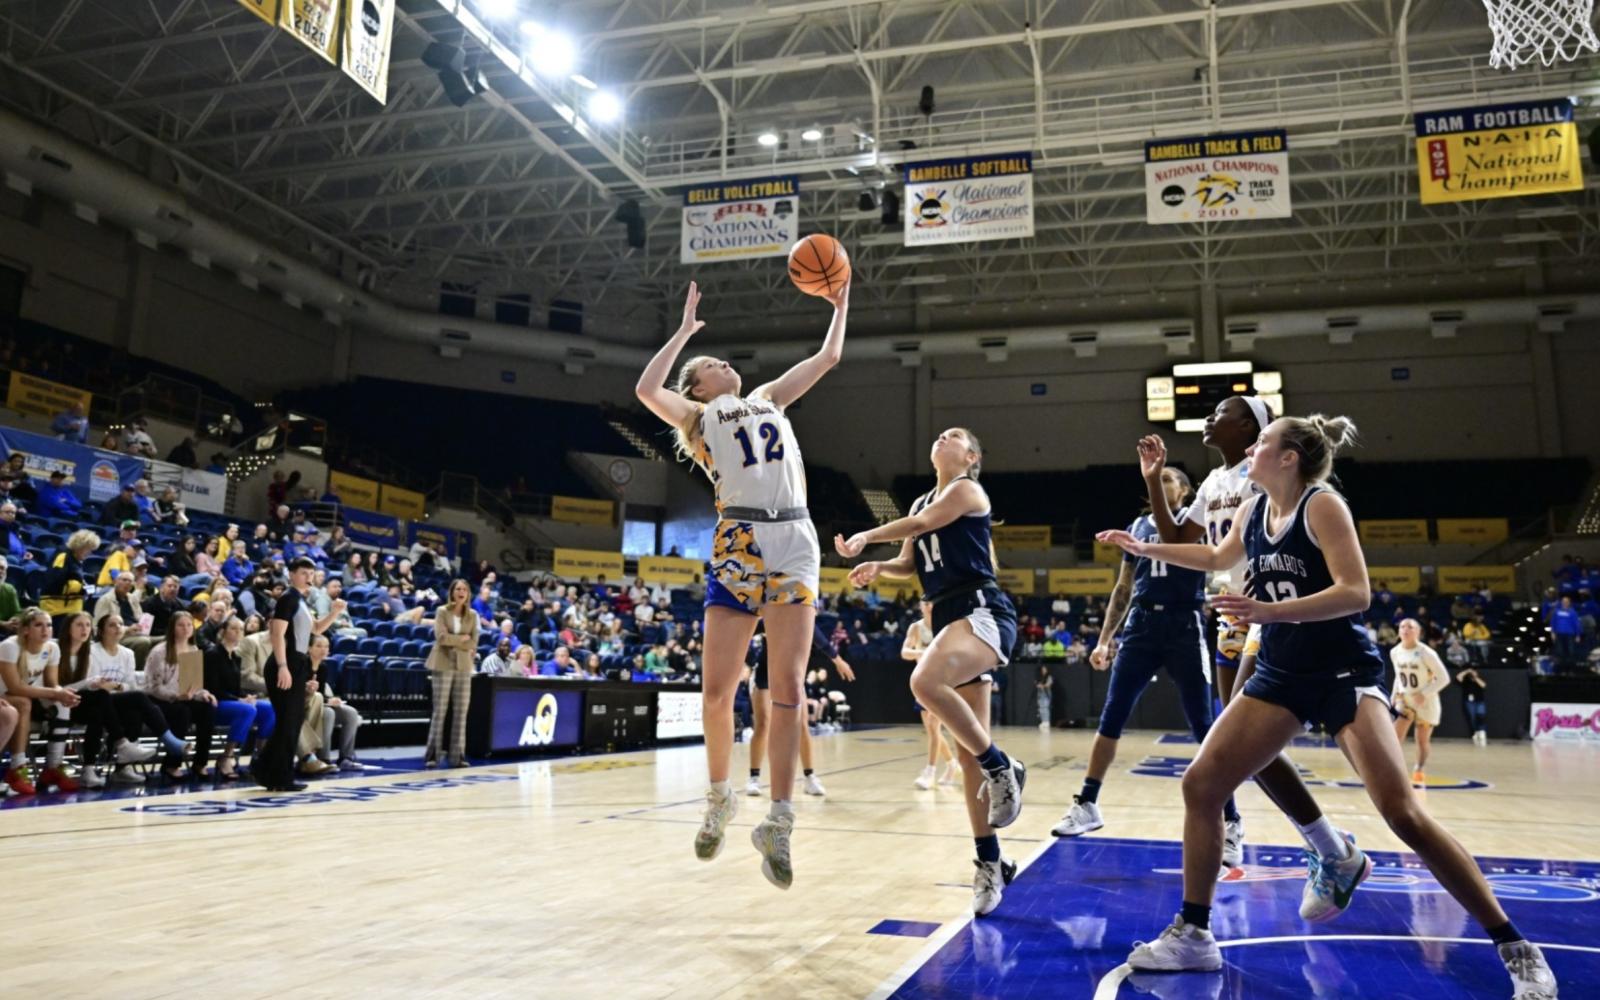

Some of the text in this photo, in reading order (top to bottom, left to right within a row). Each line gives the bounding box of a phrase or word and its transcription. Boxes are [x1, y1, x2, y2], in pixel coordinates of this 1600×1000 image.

[294, 13, 326, 47] 2020
[355, 60, 378, 88] 2021
[1425, 105, 1565, 133] RAM FOOTBALL
[1150, 136, 1282, 160] RAMBELLE TRACK & FIELD
[1465, 143, 1562, 173] National
[909, 158, 1029, 183] RAMBELLE SOFTBALL
[1155, 159, 1280, 183] NATIONAL CHAMPIONS
[1442, 167, 1570, 192] Champions
[688, 179, 794, 203] BELLE VOLLEYBALL
[953, 180, 1026, 203] National
[952, 203, 1029, 224] Champions
[1198, 207, 1239, 218] 2010
[703, 218, 778, 236] NATIONAL
[689, 229, 789, 251] CHAMPIONS
[733, 421, 785, 468] 12
[918, 532, 944, 572] 14
